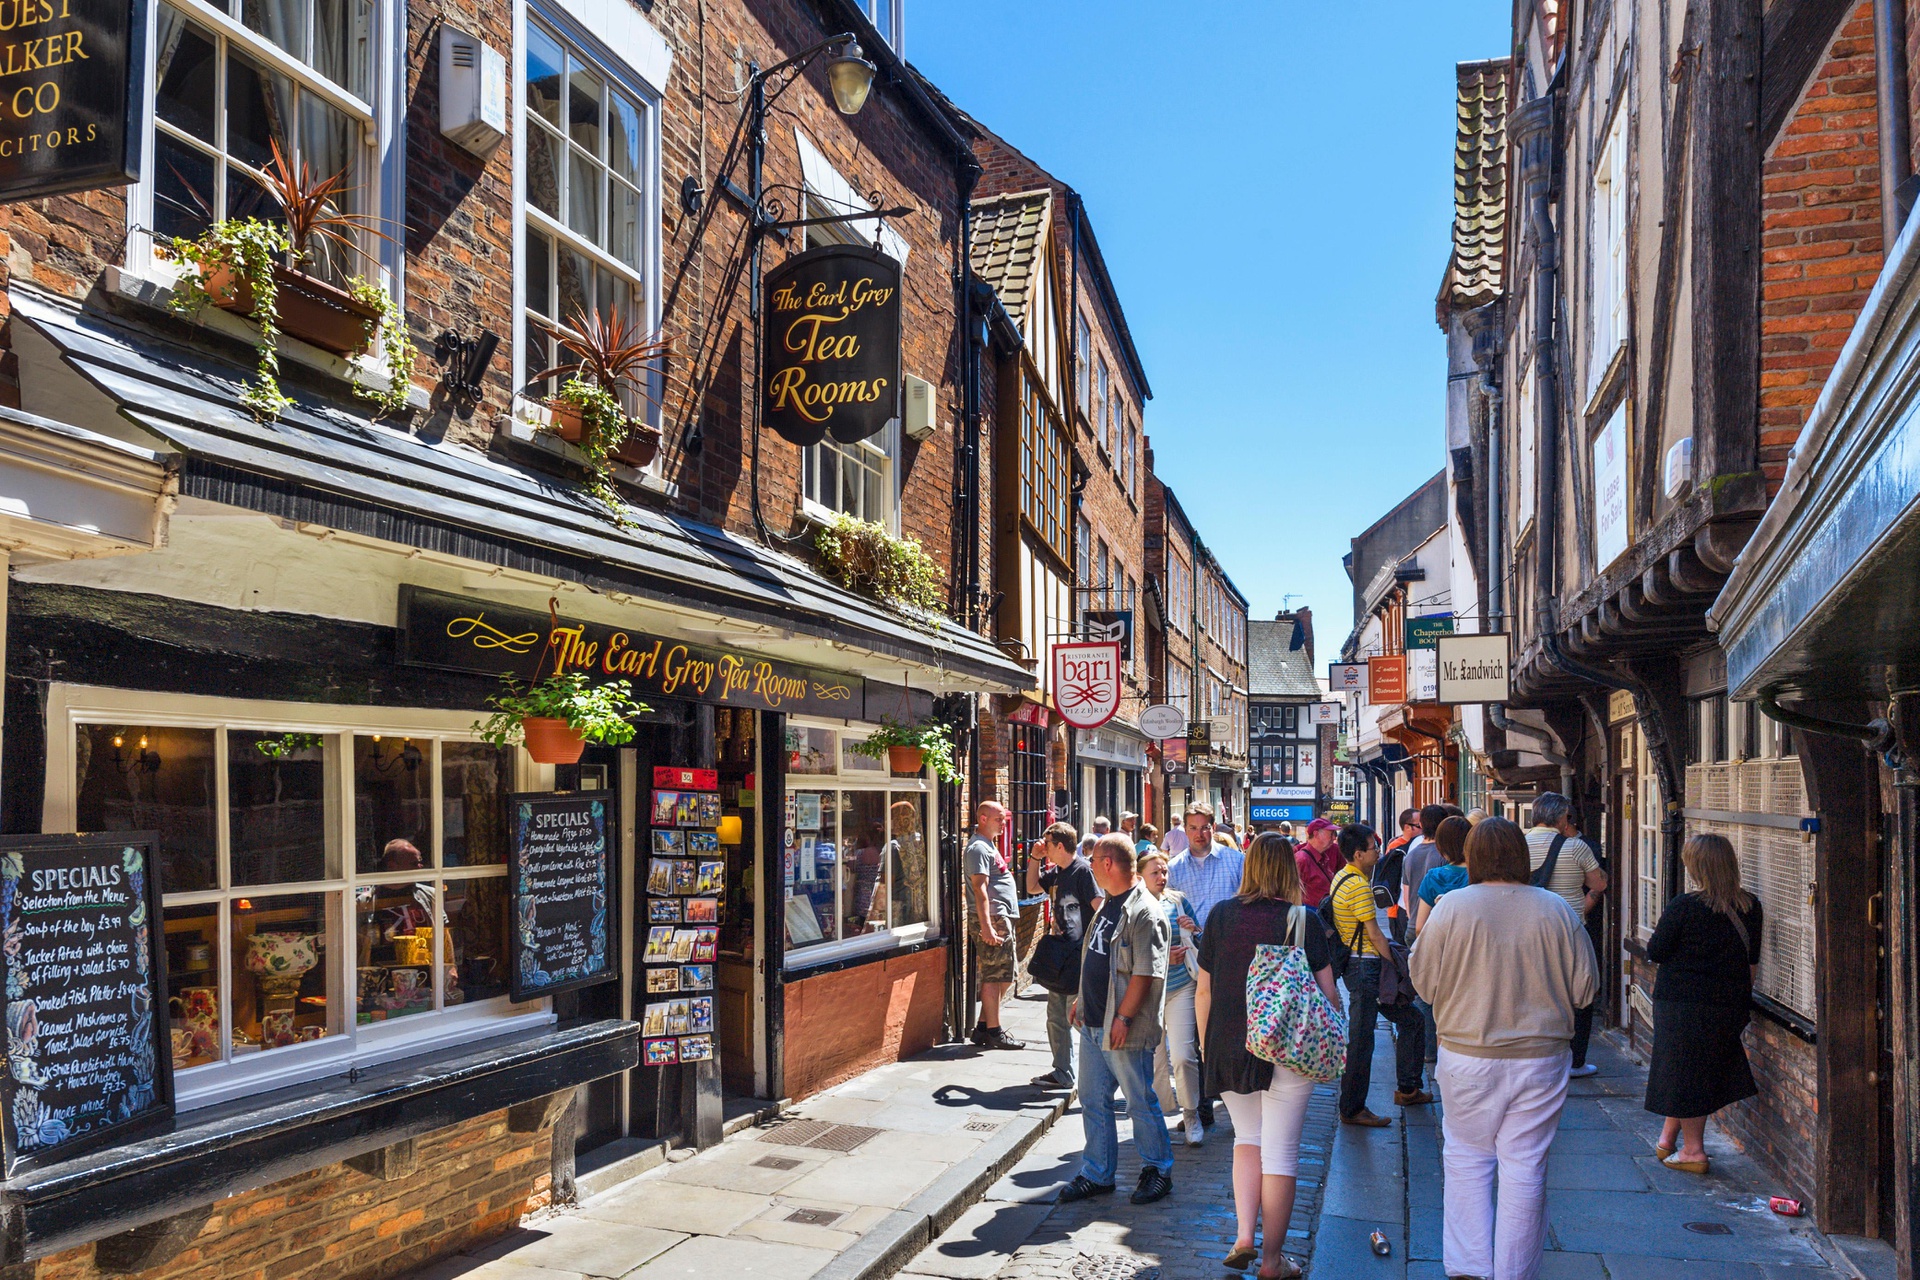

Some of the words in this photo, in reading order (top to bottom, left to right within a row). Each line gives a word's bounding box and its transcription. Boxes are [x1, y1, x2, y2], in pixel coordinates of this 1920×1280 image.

[12, 81, 61, 118] CO
[772, 281, 803, 311] The
[805, 281, 848, 308] Earl
[850, 277, 894, 312] Grey
[785, 306, 861, 363] Tea
[769, 366, 888, 423] Rooms
[1602, 474, 1621, 507] Lease
[1601, 512, 1610, 538] For
[1610, 497, 1623, 527] Sale
[550, 623, 598, 676] The
[603, 632, 663, 680] Earl
[663, 645, 715, 696] Grey
[717, 653, 751, 701] Tea
[752, 661, 808, 708] Rooms
[1060, 653, 1113, 683] bari
[1067, 652, 1110, 660] RISTORANTE
[1443, 661, 1458, 681] Mr.
[1065, 707, 1110, 715] PIZZERIA
[1276, 788, 1312, 796] Manpower
[536, 812, 590, 828] SPECIALS
[1253, 808, 1290, 818] GREGGS
[32, 864, 121, 892] SPECIALS
[22, 894, 63, 910] Selection
[63, 891, 82, 910] from
[84, 890, 99, 904] the
[24, 920, 48, 940] Soup
[50, 920, 62, 938] of
[62, 919, 80, 934] the
[80, 918, 95, 942] Day
[24, 948, 56, 967] Jacket
[57, 946, 83, 962] Potato
[86, 942, 104, 958] with
[106, 940, 128, 956] choice
[31, 965, 42, 986] of
[42, 964, 72, 987] filling
[35, 991, 68, 1013] Smoked
[68, 987, 88, 1006] Fish
[89, 984, 117, 1004] Platter
[36, 1018, 74, 1038] Creamed
[75, 1011, 116, 1030] Mushrooms
[70, 1033, 94, 1050] Salad
[53, 1105, 77, 1120] MORE
